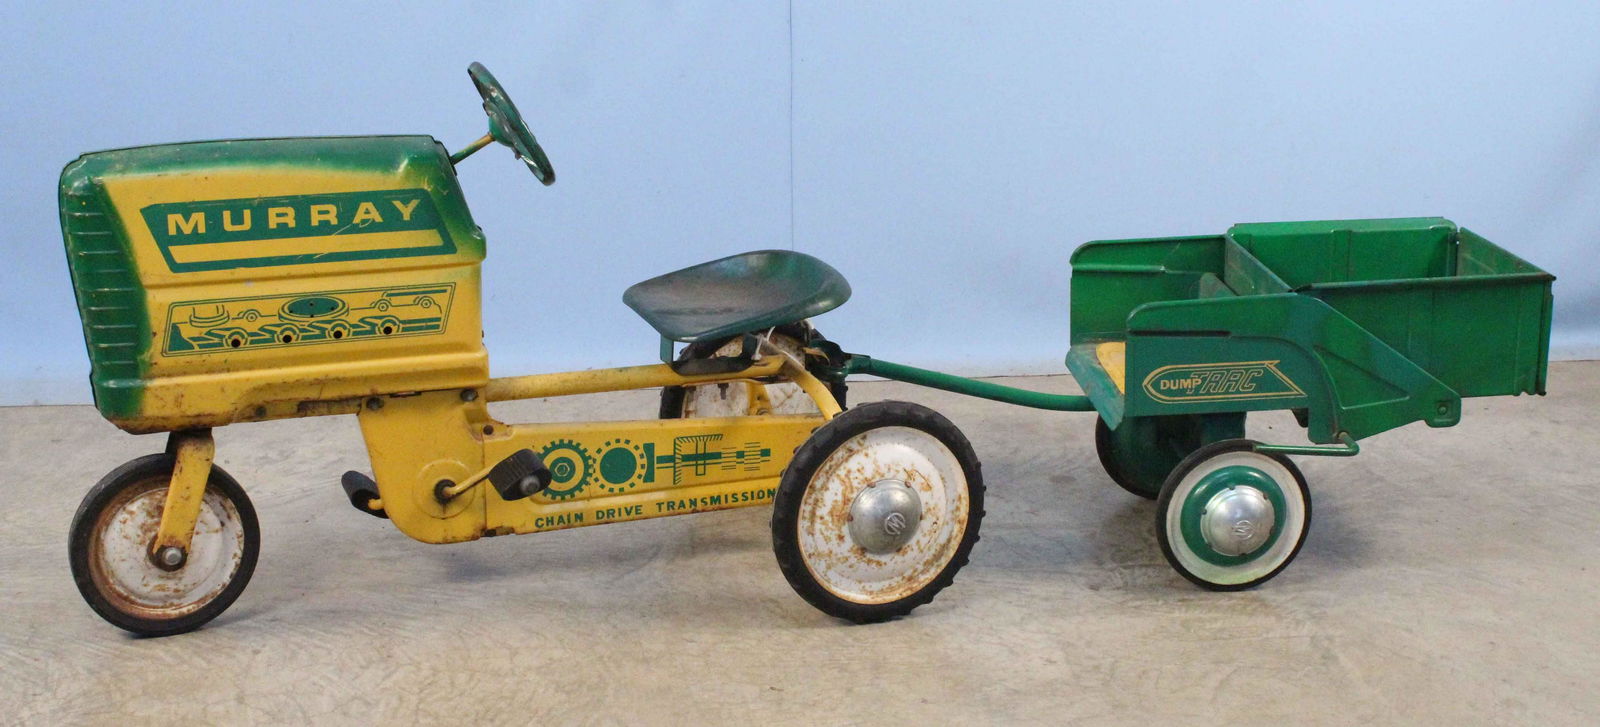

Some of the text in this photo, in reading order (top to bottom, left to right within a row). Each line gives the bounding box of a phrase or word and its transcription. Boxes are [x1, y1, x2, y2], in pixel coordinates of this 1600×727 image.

[168, 199, 420, 235] MURRAY
[1160, 369, 1263, 394] DUMP TRAC
[534, 487, 776, 529] CHAIN DRIVE TRANSMISSION
